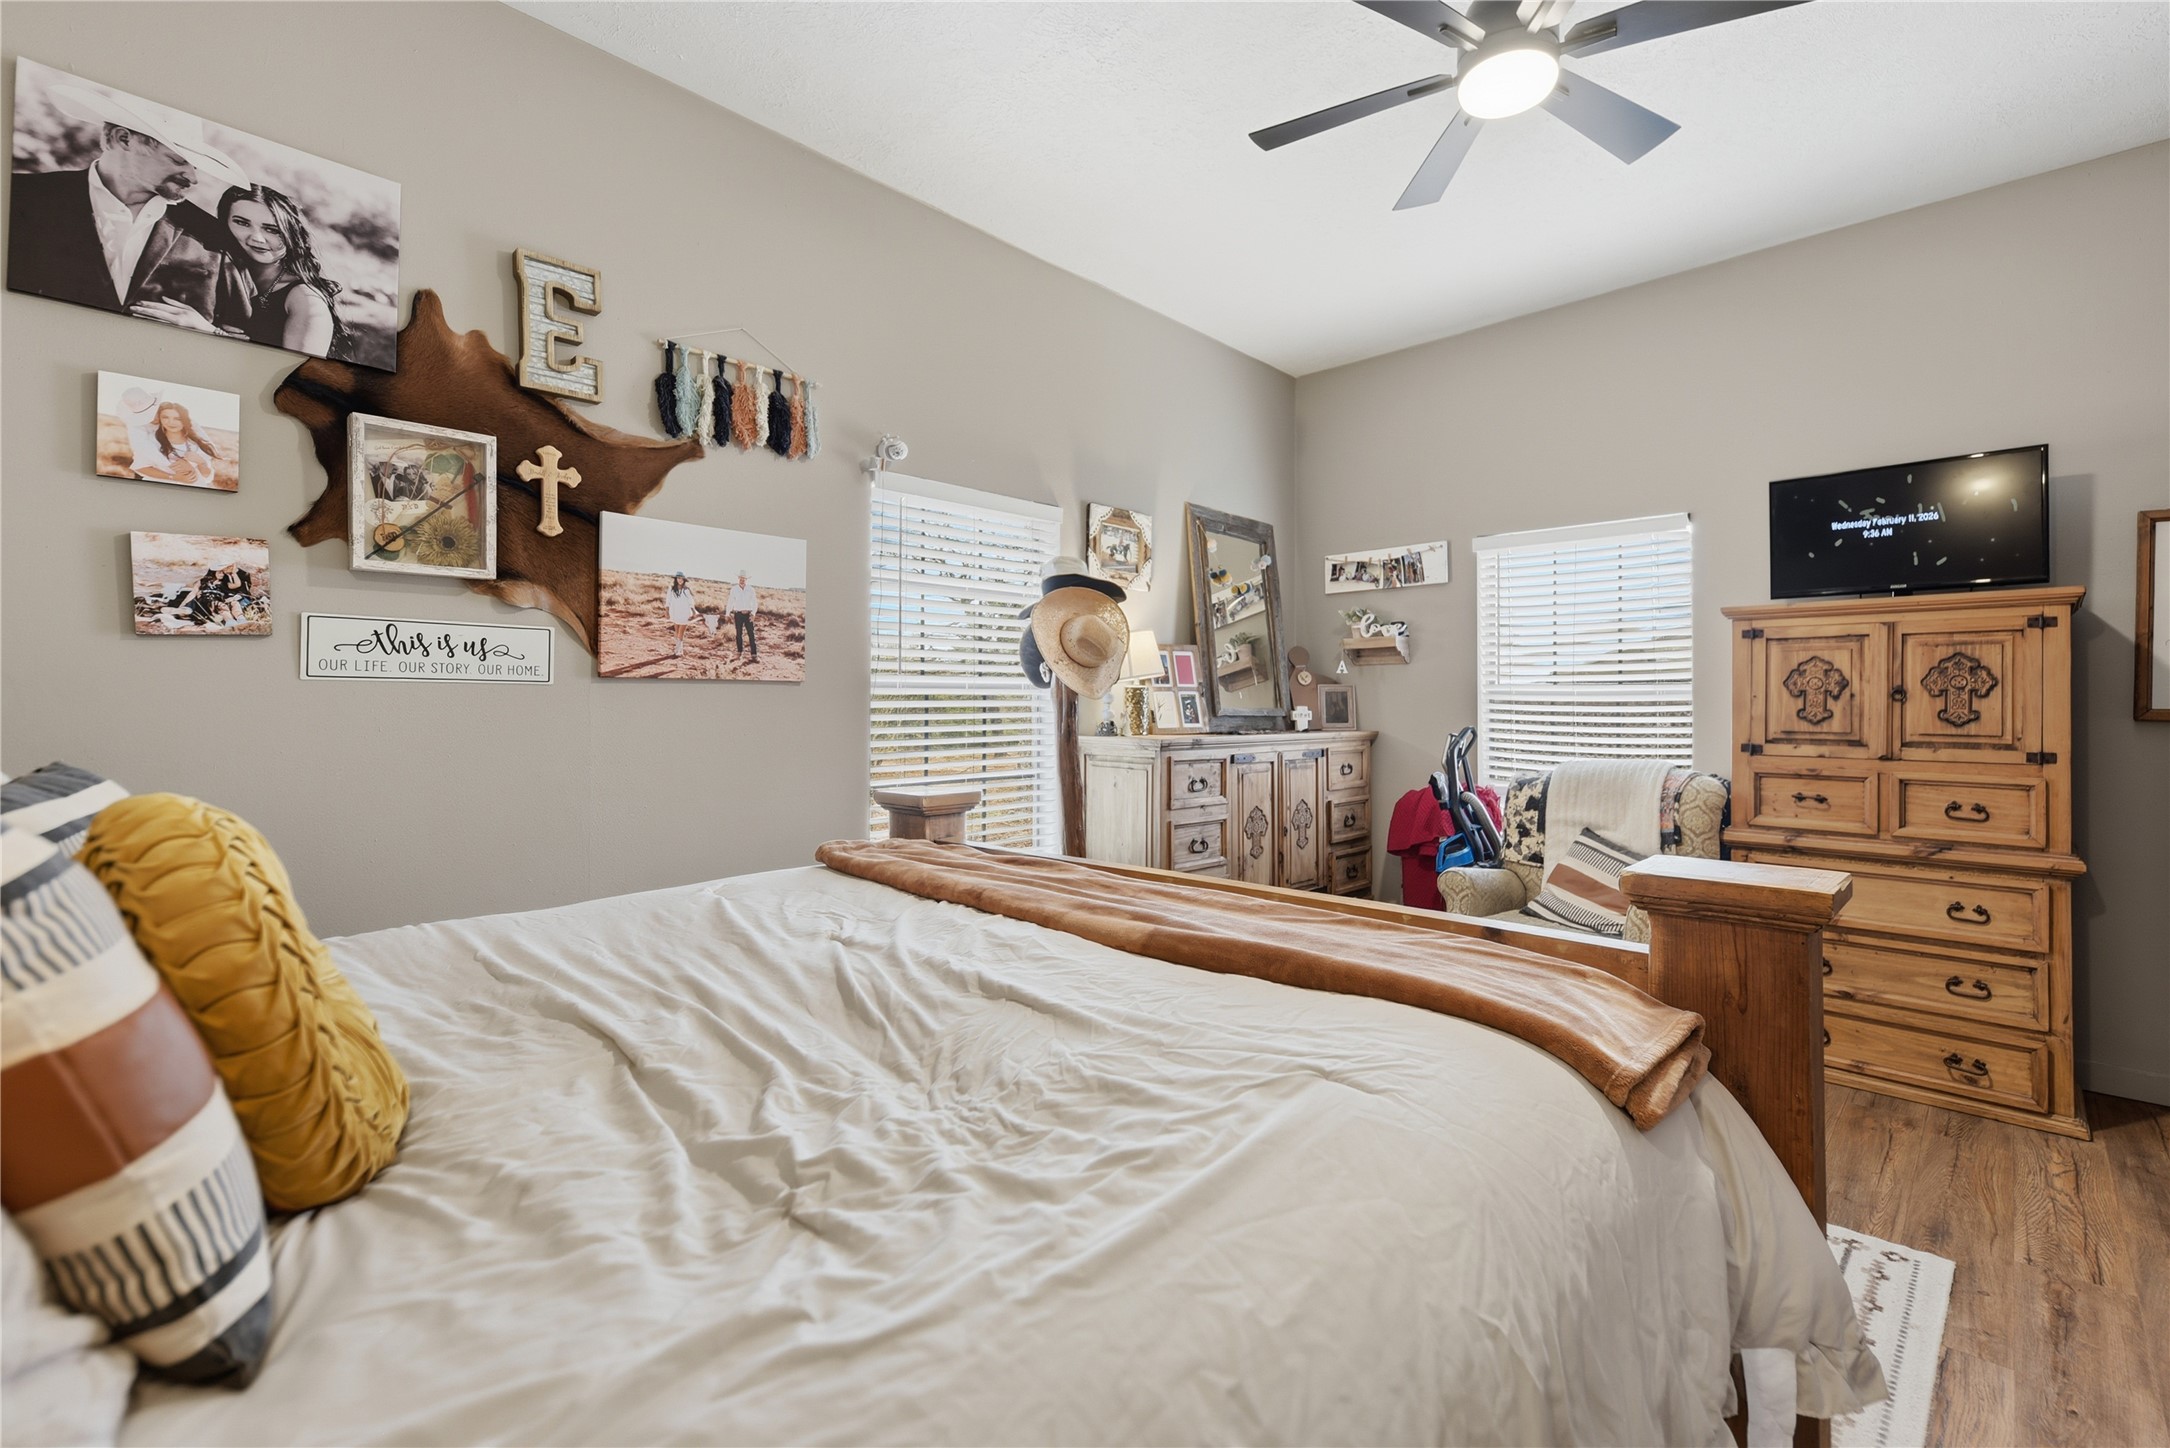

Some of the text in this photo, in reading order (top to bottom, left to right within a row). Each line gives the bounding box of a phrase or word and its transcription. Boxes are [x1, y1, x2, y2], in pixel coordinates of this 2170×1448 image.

[512, 248, 603, 405] E
[1831, 519, 1871, 530] Wednesday
[1917, 511, 1939, 522] 2026
[1862, 527, 1893, 539] 9:36 AM
[334, 623, 525, 662] this is us
[318, 658, 348, 671] OUR
[354, 660, 392, 673] LIFE.
[398, 661, 426, 673] OUR
[477, 663, 502, 675] OUR
[507, 664, 544, 677] HOME.
[1336, 660, 1348, 673] A
